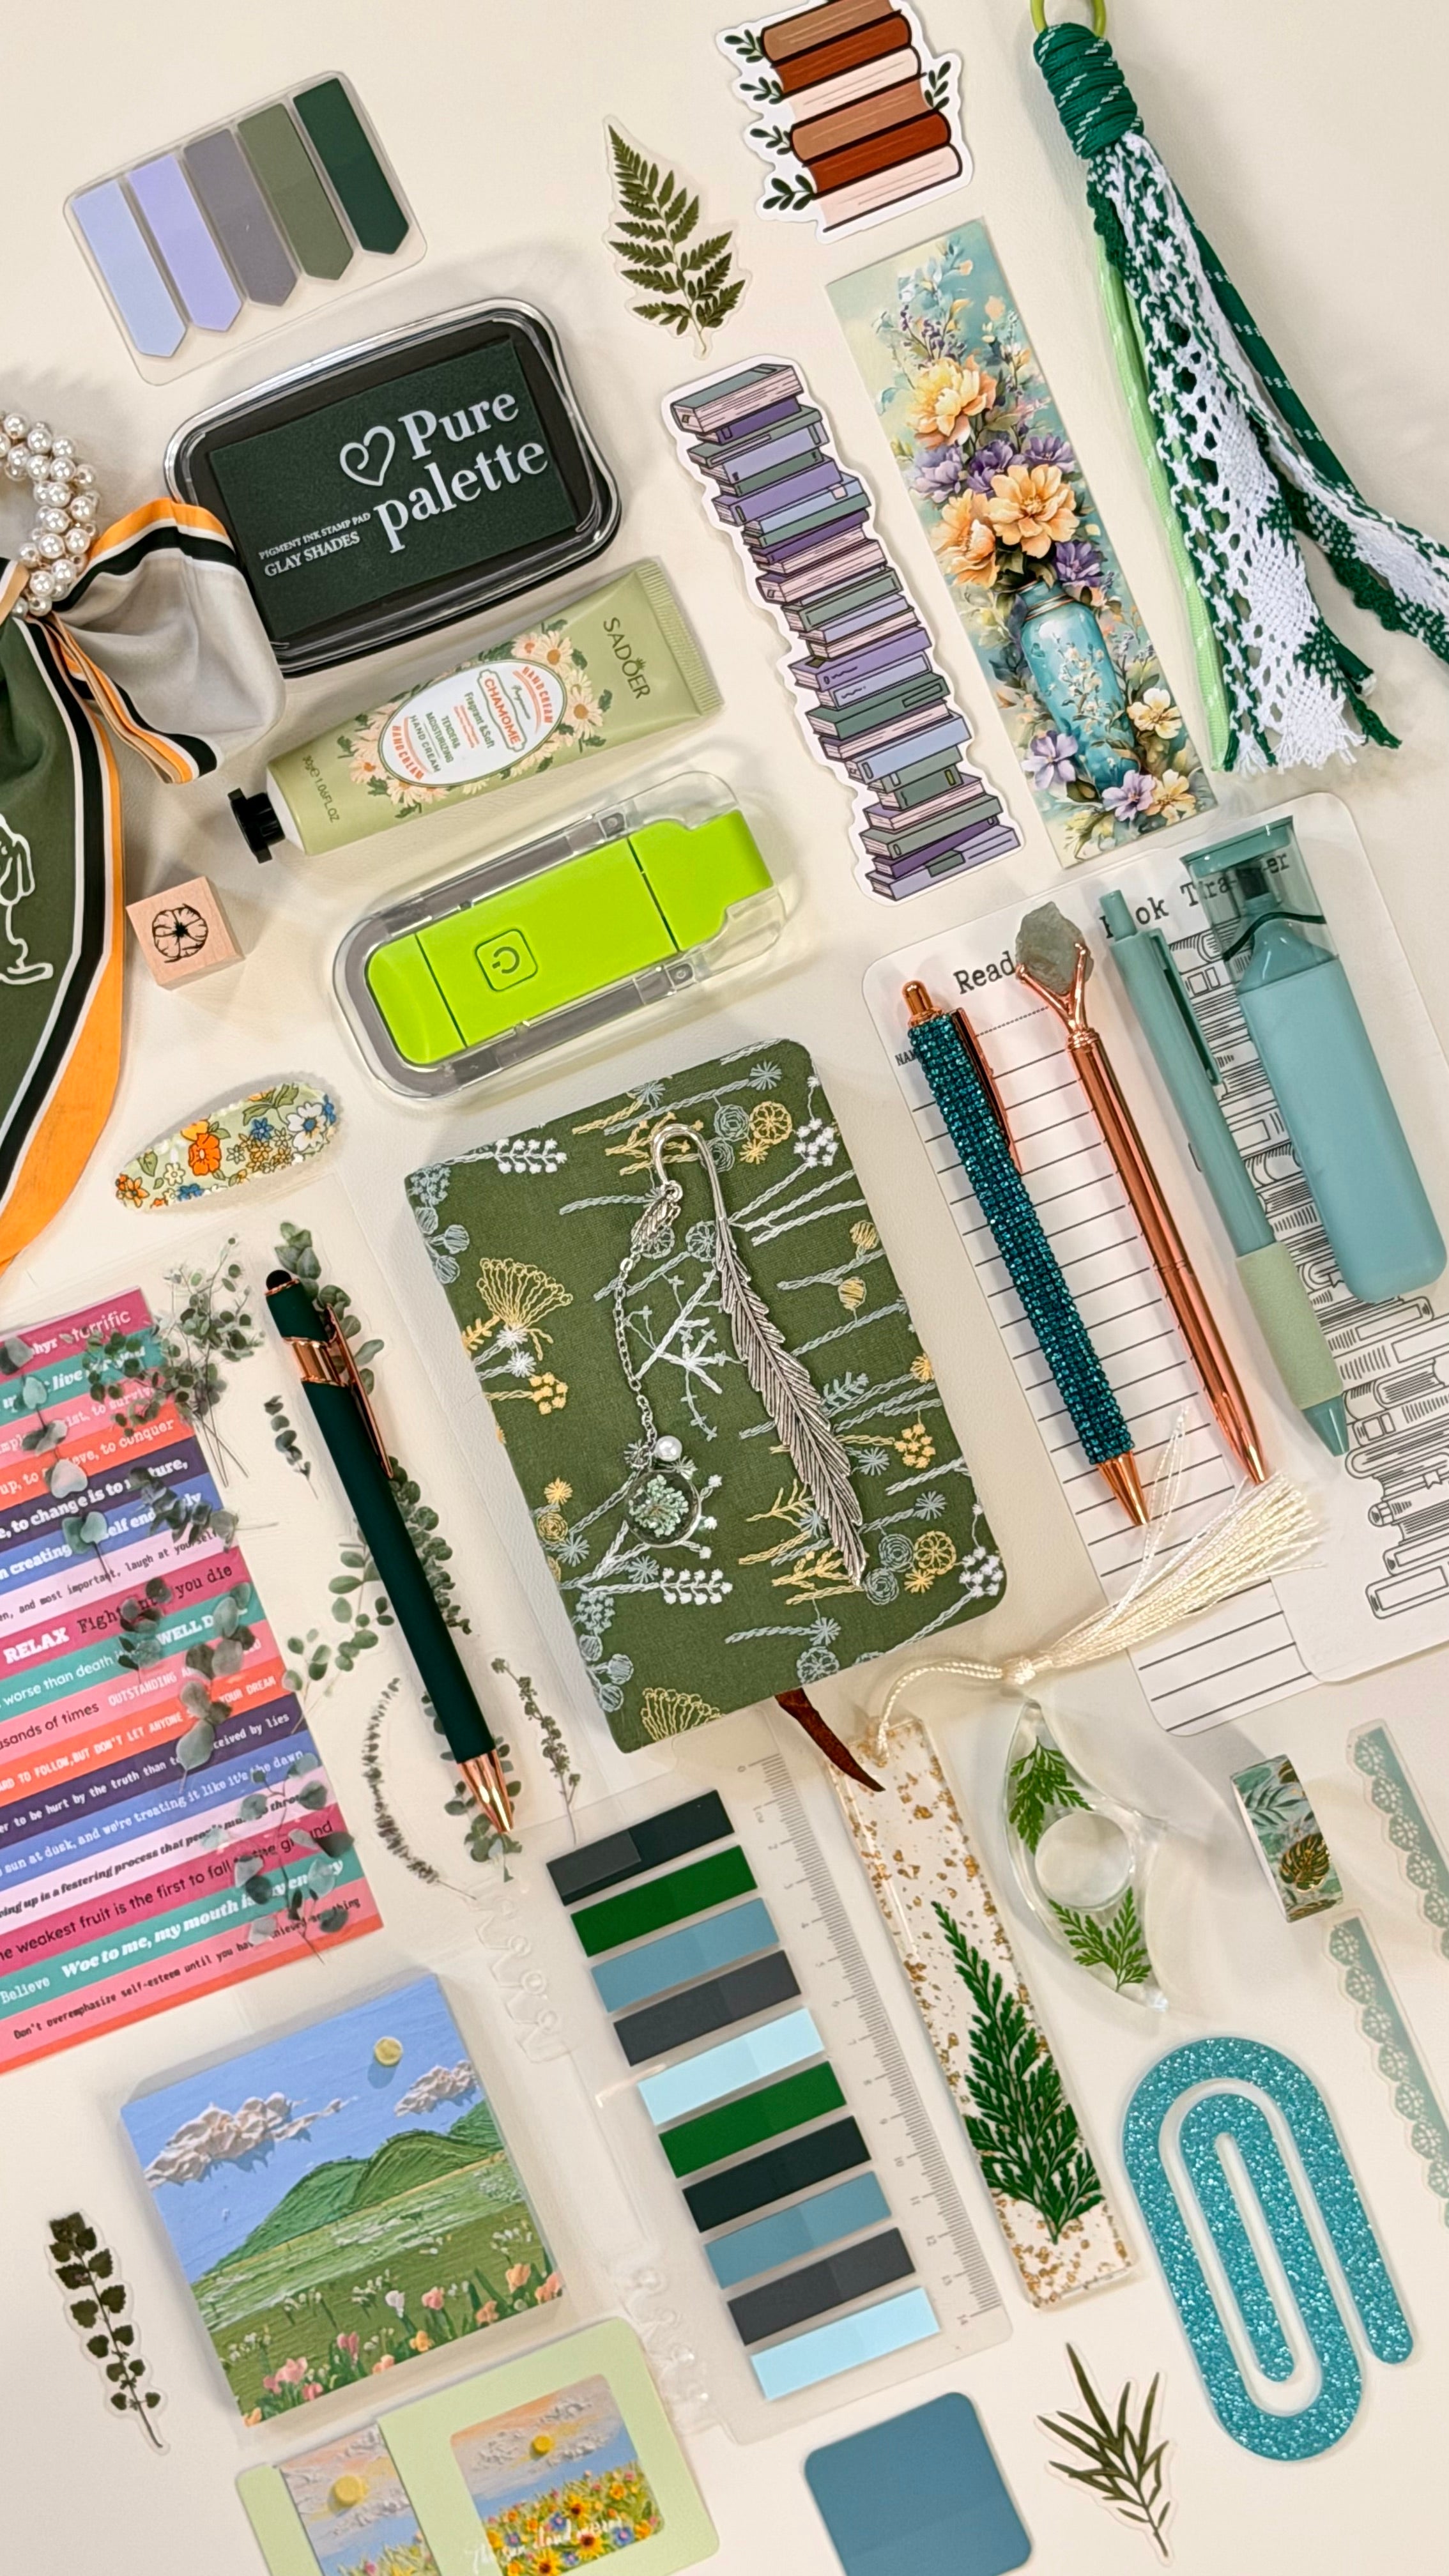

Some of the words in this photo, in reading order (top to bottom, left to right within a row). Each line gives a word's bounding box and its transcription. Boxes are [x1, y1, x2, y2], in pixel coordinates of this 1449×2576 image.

[397, 394, 519, 460] Pure
[373, 443, 548, 554] palette
[258, 537, 302, 560] PIGMENT
[302, 531, 321, 543] INK
[321, 519, 351, 537] STAMP
[351, 512, 371, 525] PAD
[264, 553, 302, 577] GLAY
[303, 531, 360, 562] SHADES
[603, 617, 650, 699] SADOER
[464, 692, 484, 724] Fragrant
[484, 678, 521, 745] CHAMOME
[522, 666, 545, 690] HAND
[539, 690, 553, 723] CREAM
[392, 725, 405, 751] HAND
[399, 751, 425, 780] CREAM
[410, 715, 426, 740] HAND
[422, 740, 441, 772] CREAM
[425, 712, 454, 763] MOISTURIZING
[953, 950, 1016, 995] Read
[1180, 853, 1289, 908] Traer
[52, 1370, 83, 1391] live
[91, 1406, 106, 1416] to
[109, 1386, 155, 1410] surviv
[23, 1472, 39, 1485] to
[100, 1442, 116, 1455] to
[11, 1519, 29, 1533] to
[31, 1496, 88, 1526] change
[87, 1489, 105, 1503] is
[105, 1482, 123, 1496] to
[10, 1544, 73, 1574] creating
[19, 1599, 36, 1614] and
[40, 1591, 63, 1606] most
[67, 1569, 121, 1595] important,
[125, 1555, 154, 1572] laugh
[158, 1548, 169, 1560] at
[3, 1627, 70, 1664] RELAX
[175, 1578, 203, 1598] you
[207, 1565, 233, 1584] die
[3, 1683, 42, 1706] worse
[43, 1673, 74, 1690] than
[75, 1656, 114, 1678] death
[156, 1621, 203, 1645] WELL
[18, 1771, 32, 1784] TO
[94, 1735, 123, 1755] DON'T
[126, 1727, 144, 1742] LET
[148, 1712, 183, 1733] ANYONE
[219, 1689, 243, 1704] YOUR
[246, 1676, 277, 1696] DREAM
[45, 1715, 59, 1731] of
[61, 1703, 100, 1725] times
[108, 1672, 178, 1707] OUTSTANDING
[14, 1817, 27, 1827] to
[29, 1809, 43, 1821] be
[45, 1798, 70, 1815] hurt
[72, 1793, 86, 1804] by
[89, 1784, 107, 1797] the
[111, 1771, 140, 1789] truth
[143, 1761, 167, 1776] than
[213, 1728, 247, 1749] ceived
[249, 1724, 263, 1736] by
[265, 1713, 290, 1728] lies
[4, 1859, 27, 1874] sun
[29, 1852, 43, 1864] at
[45, 1840, 78, 1859] dusk,
[78, 1827, 102, 1845] and
[102, 1818, 133, 1836] we're
[134, 1796, 187, 1823] treating
[187, 1791, 201, 1803] it
[201, 1781, 227, 1797] like
[229, 1769, 249, 1784] it's
[273, 1751, 303, 1768] dawn
[15, 1922, 77, 1953] weakest
[79, 1908, 111, 1929] fruit
[113, 1903, 127, 1916] is
[129, 1892, 154, 1910] the
[157, 1879, 187, 1899] first
[188, 1873, 206, 1887] to
[208, 1860, 232, 1880] fall
[24, 1897, 39, 1908] up
[41, 1892, 51, 1903] is
[53, 1889, 60, 1897] a
[61, 1866, 112, 1894] festering
[114, 1849, 159, 1875] process
[160, 1840, 185, 1856] that
[1, 1977, 51, 2004] Believe
[61, 1956, 100, 1978] Woe
[101, 1949, 120, 1964] to
[122, 1936, 153, 1956] me,
[155, 1923, 182, 1944] my
[183, 1899, 240, 1931] mouth
[288, 1860, 344, 1890] eny
[14, 2022, 43, 2040] Don't
[121, 1969, 181, 1997] self-esteem
[185, 1955, 213, 1974] until
[216, 1948, 234, 1963] you
